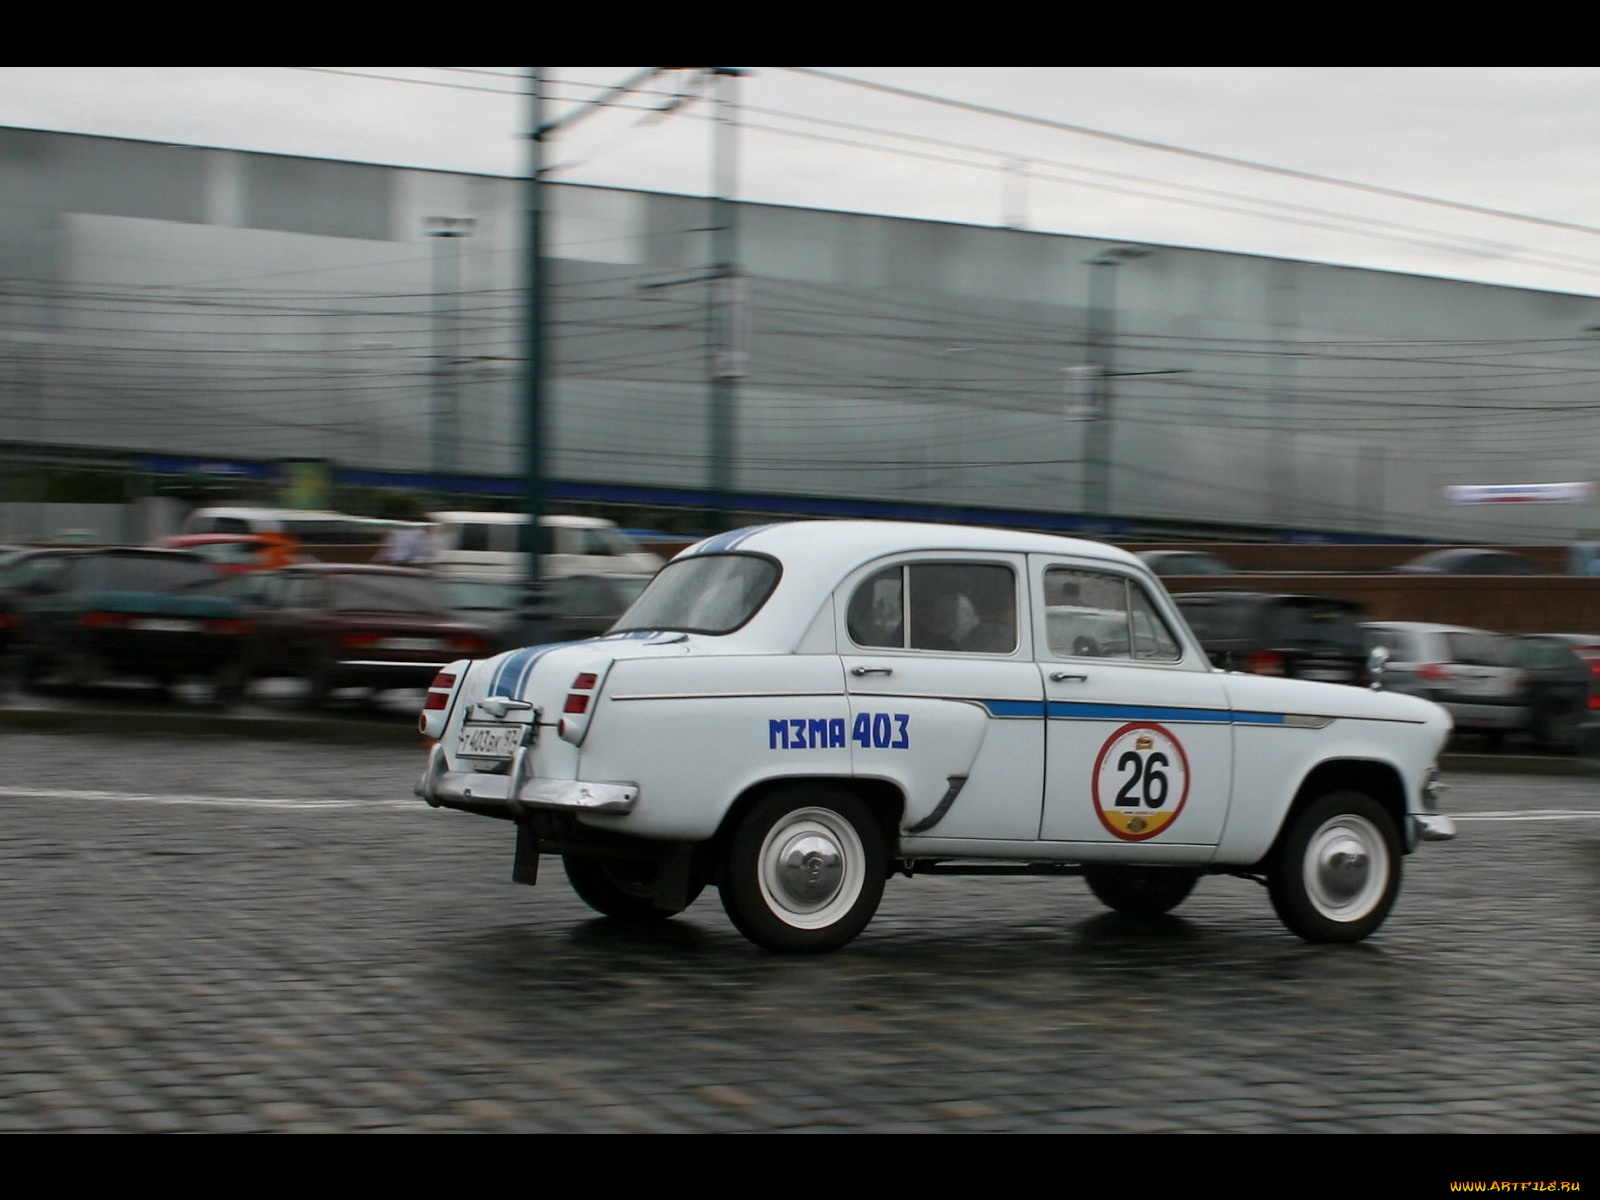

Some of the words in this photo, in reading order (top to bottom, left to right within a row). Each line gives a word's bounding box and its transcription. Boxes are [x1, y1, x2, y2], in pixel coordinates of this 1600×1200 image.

[769, 719, 846, 749] МЗМА
[852, 713, 910, 749] 403
[1114, 751, 1169, 809] 26
